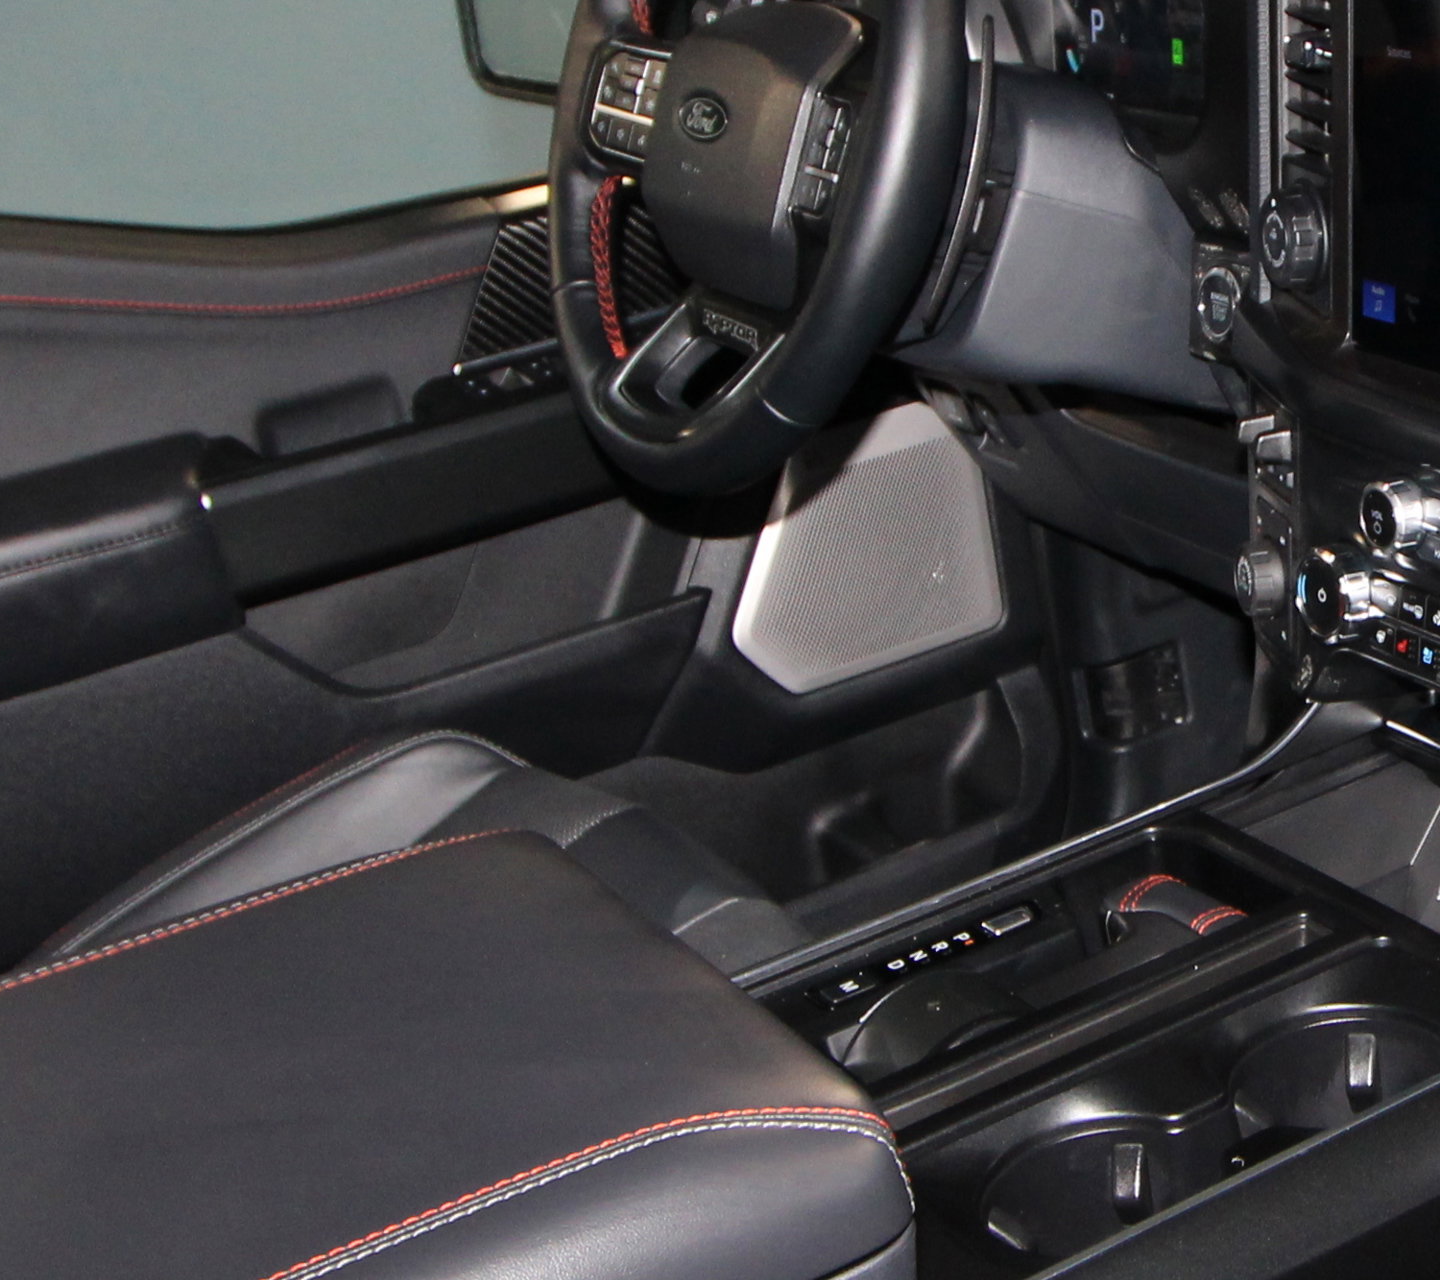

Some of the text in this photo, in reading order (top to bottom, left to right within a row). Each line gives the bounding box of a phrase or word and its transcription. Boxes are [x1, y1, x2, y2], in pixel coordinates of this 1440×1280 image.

[1090, 7, 1105, 43] P
[703, 308, 759, 351] RAPTOR
[887, 931, 971, 970] P R N D
